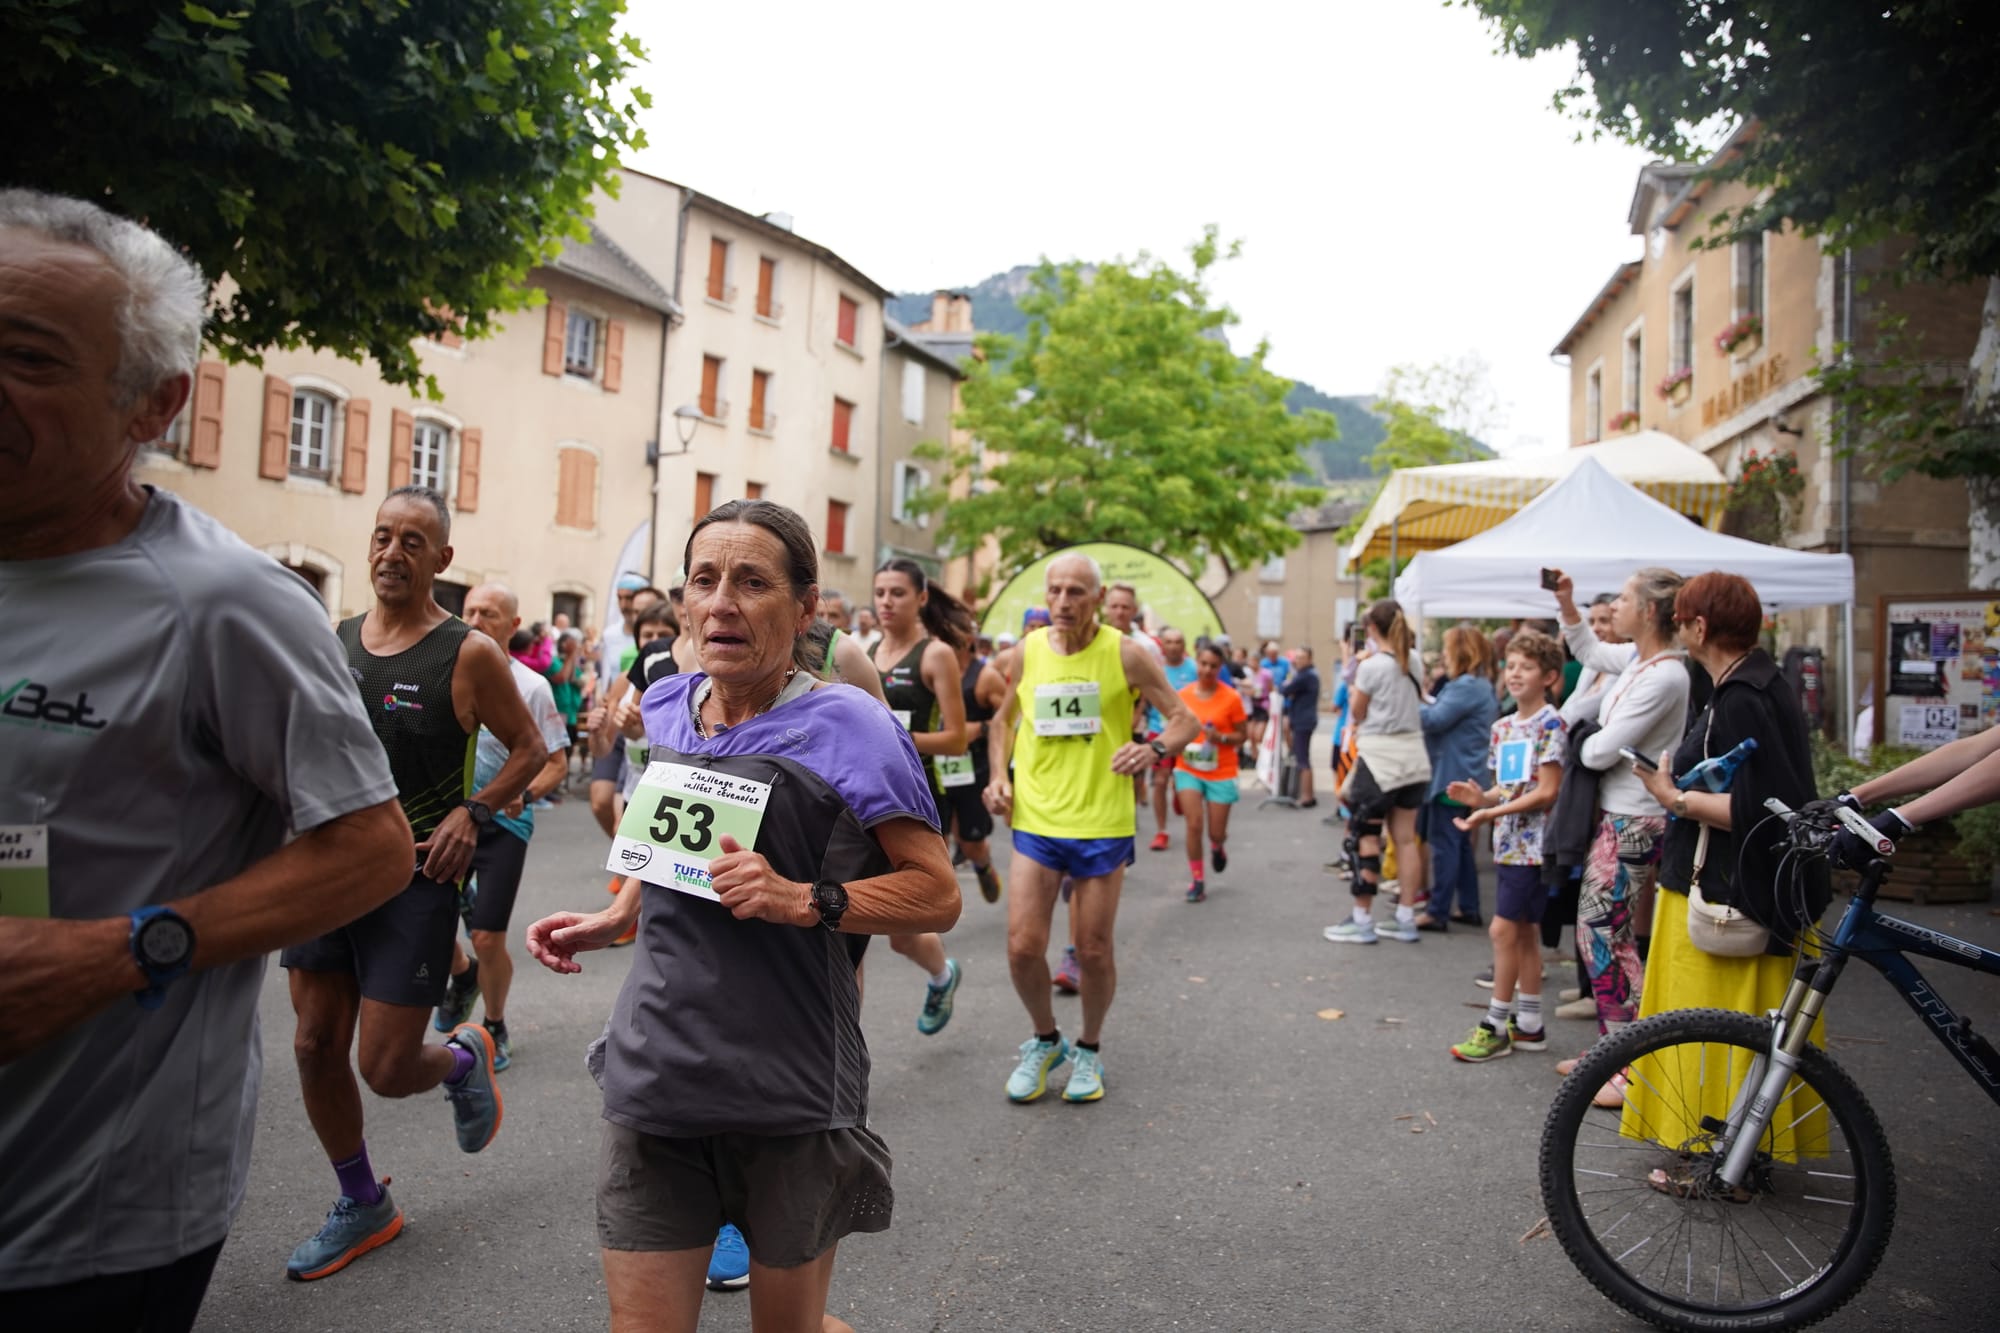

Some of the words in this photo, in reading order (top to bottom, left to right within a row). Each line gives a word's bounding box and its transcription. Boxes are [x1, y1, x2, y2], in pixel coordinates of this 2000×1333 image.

[1050, 697, 1082, 718] 14
[1928, 707, 1955, 728] 05
[941, 761, 960, 775] 12
[1507, 754, 1516, 772] 1
[683, 782, 712, 793] vallées
[717, 789, 759, 804] cévenoles
[690, 772, 734, 790] Challenge
[739, 784, 757, 793] des
[649, 795, 715, 852] 53
[621, 849, 647, 863] BFP
[674, 863, 714, 882] TUFF'S
